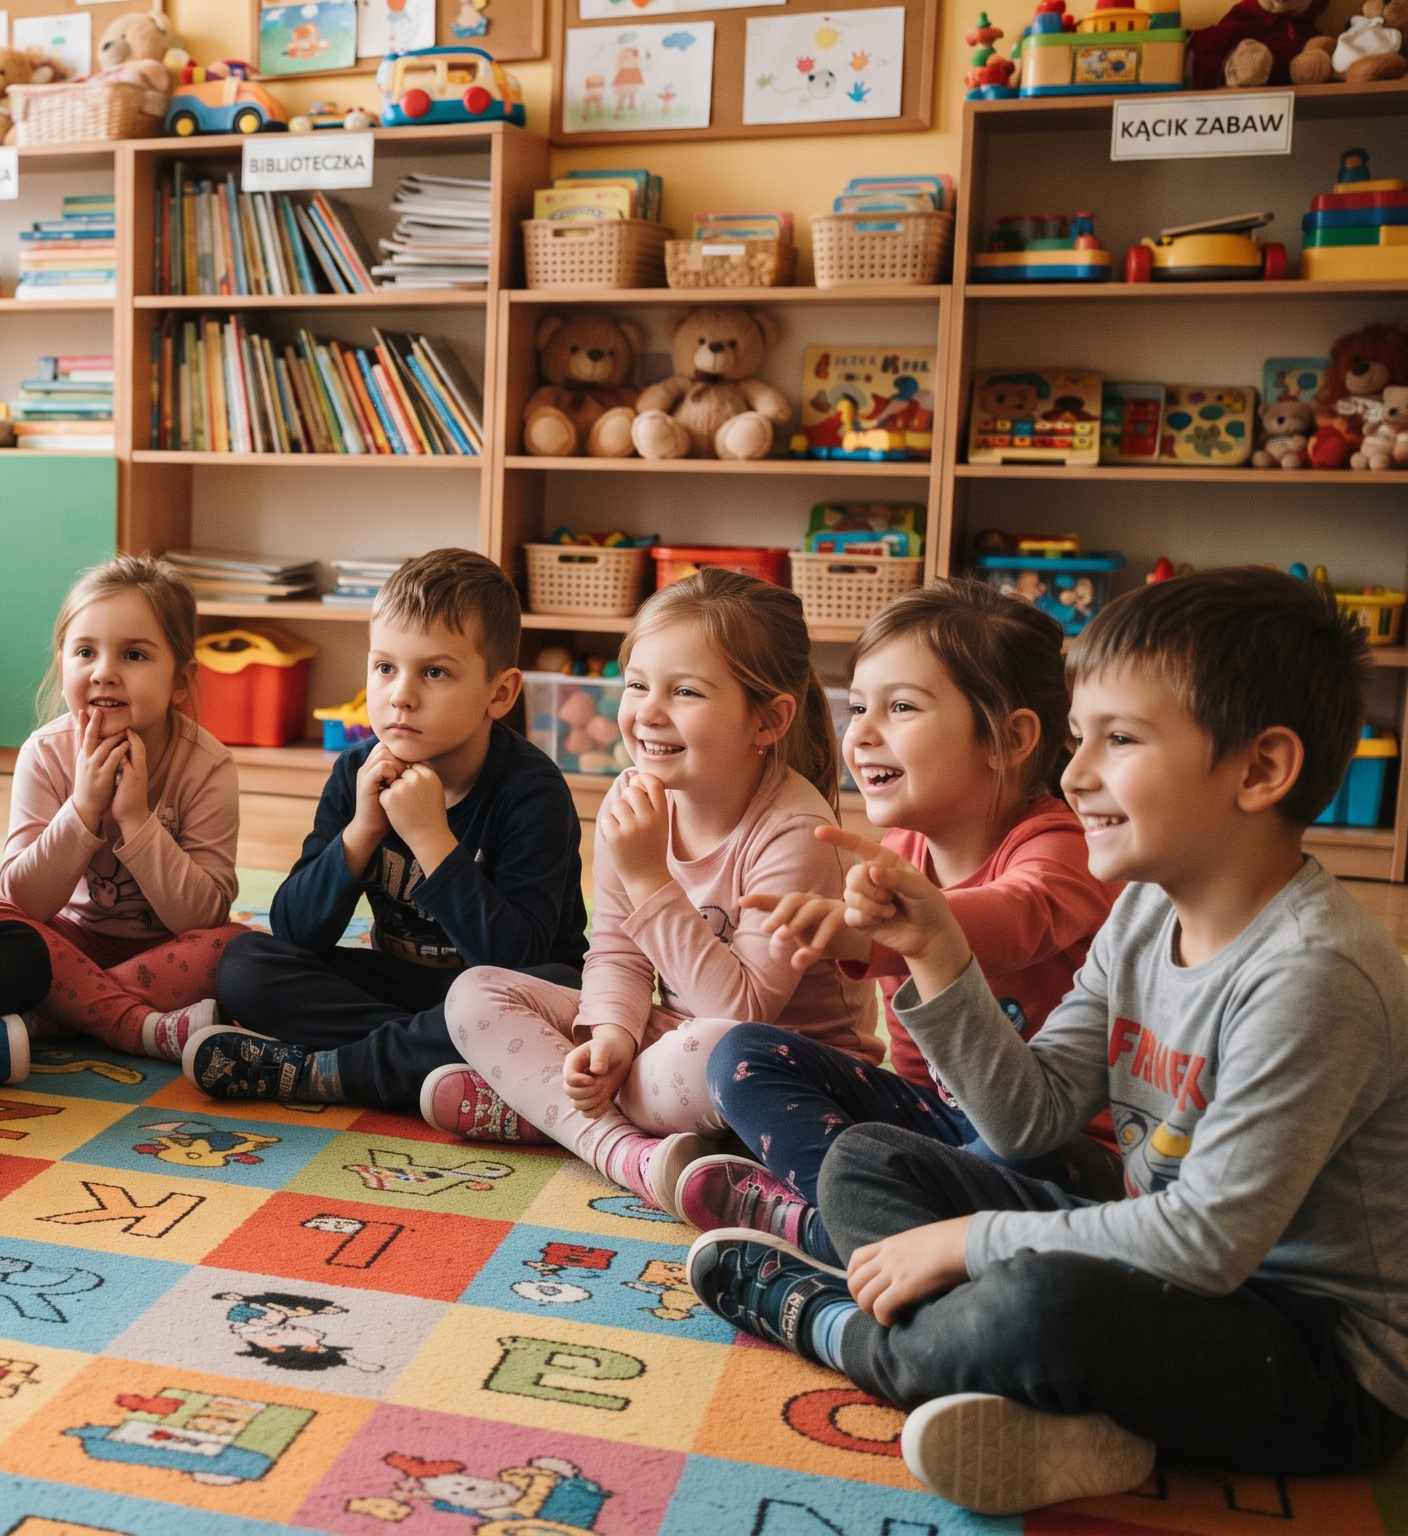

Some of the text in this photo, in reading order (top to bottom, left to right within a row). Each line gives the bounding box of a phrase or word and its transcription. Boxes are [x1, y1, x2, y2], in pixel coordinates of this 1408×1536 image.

[1120, 114, 1284, 142] KĄCIK ZABAW
[249, 154, 366, 173] BIBLIOTECZKA
